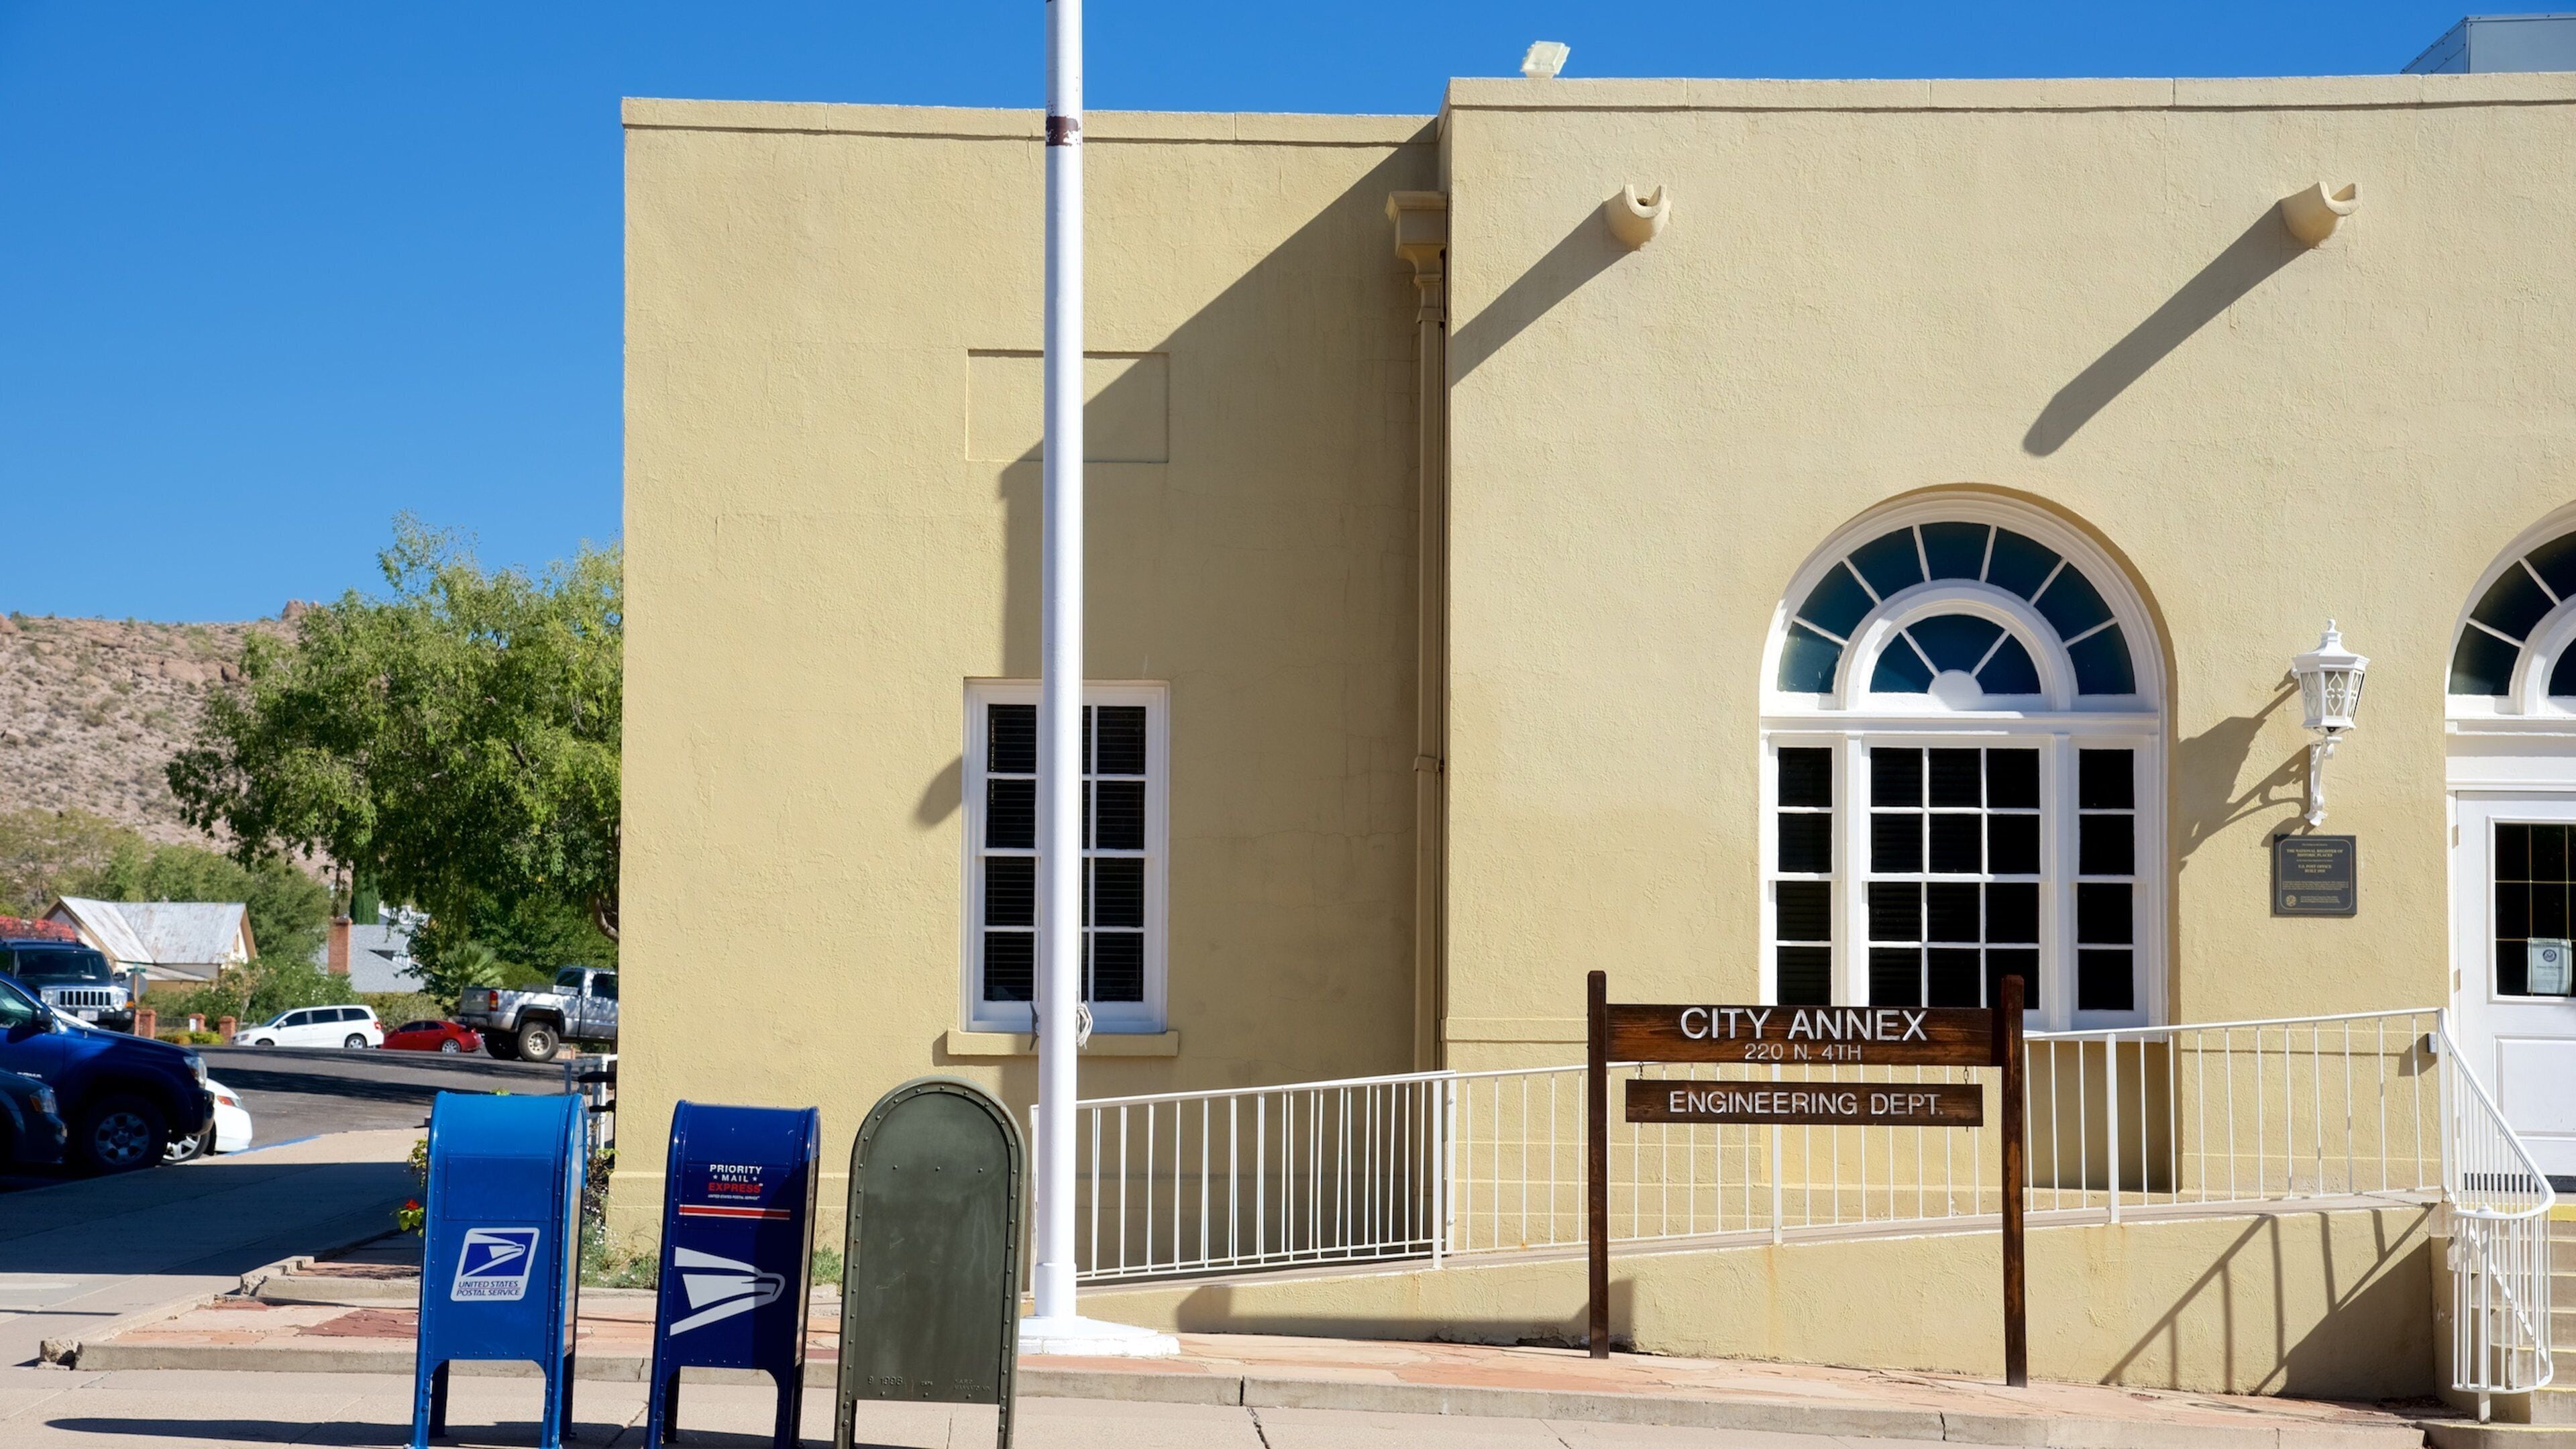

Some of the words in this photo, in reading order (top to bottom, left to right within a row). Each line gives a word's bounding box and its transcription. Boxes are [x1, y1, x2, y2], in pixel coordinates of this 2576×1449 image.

[1680, 1007, 1772, 1039] CITY
[1787, 1008, 1928, 1040] ANNEX
[1744, 1043, 1784, 1061] 220
[1793, 1044, 1813, 1061] N.
[1821, 1044, 1862, 1061] 4TH
[1669, 1090, 1858, 1115] ENGINEERING
[1870, 1093, 1944, 1116] DEPT.
[709, 1164, 763, 1175] PRIORITY
[721, 1174, 749, 1183] MAIL
[708, 1182, 761, 1193] EXPRESS
